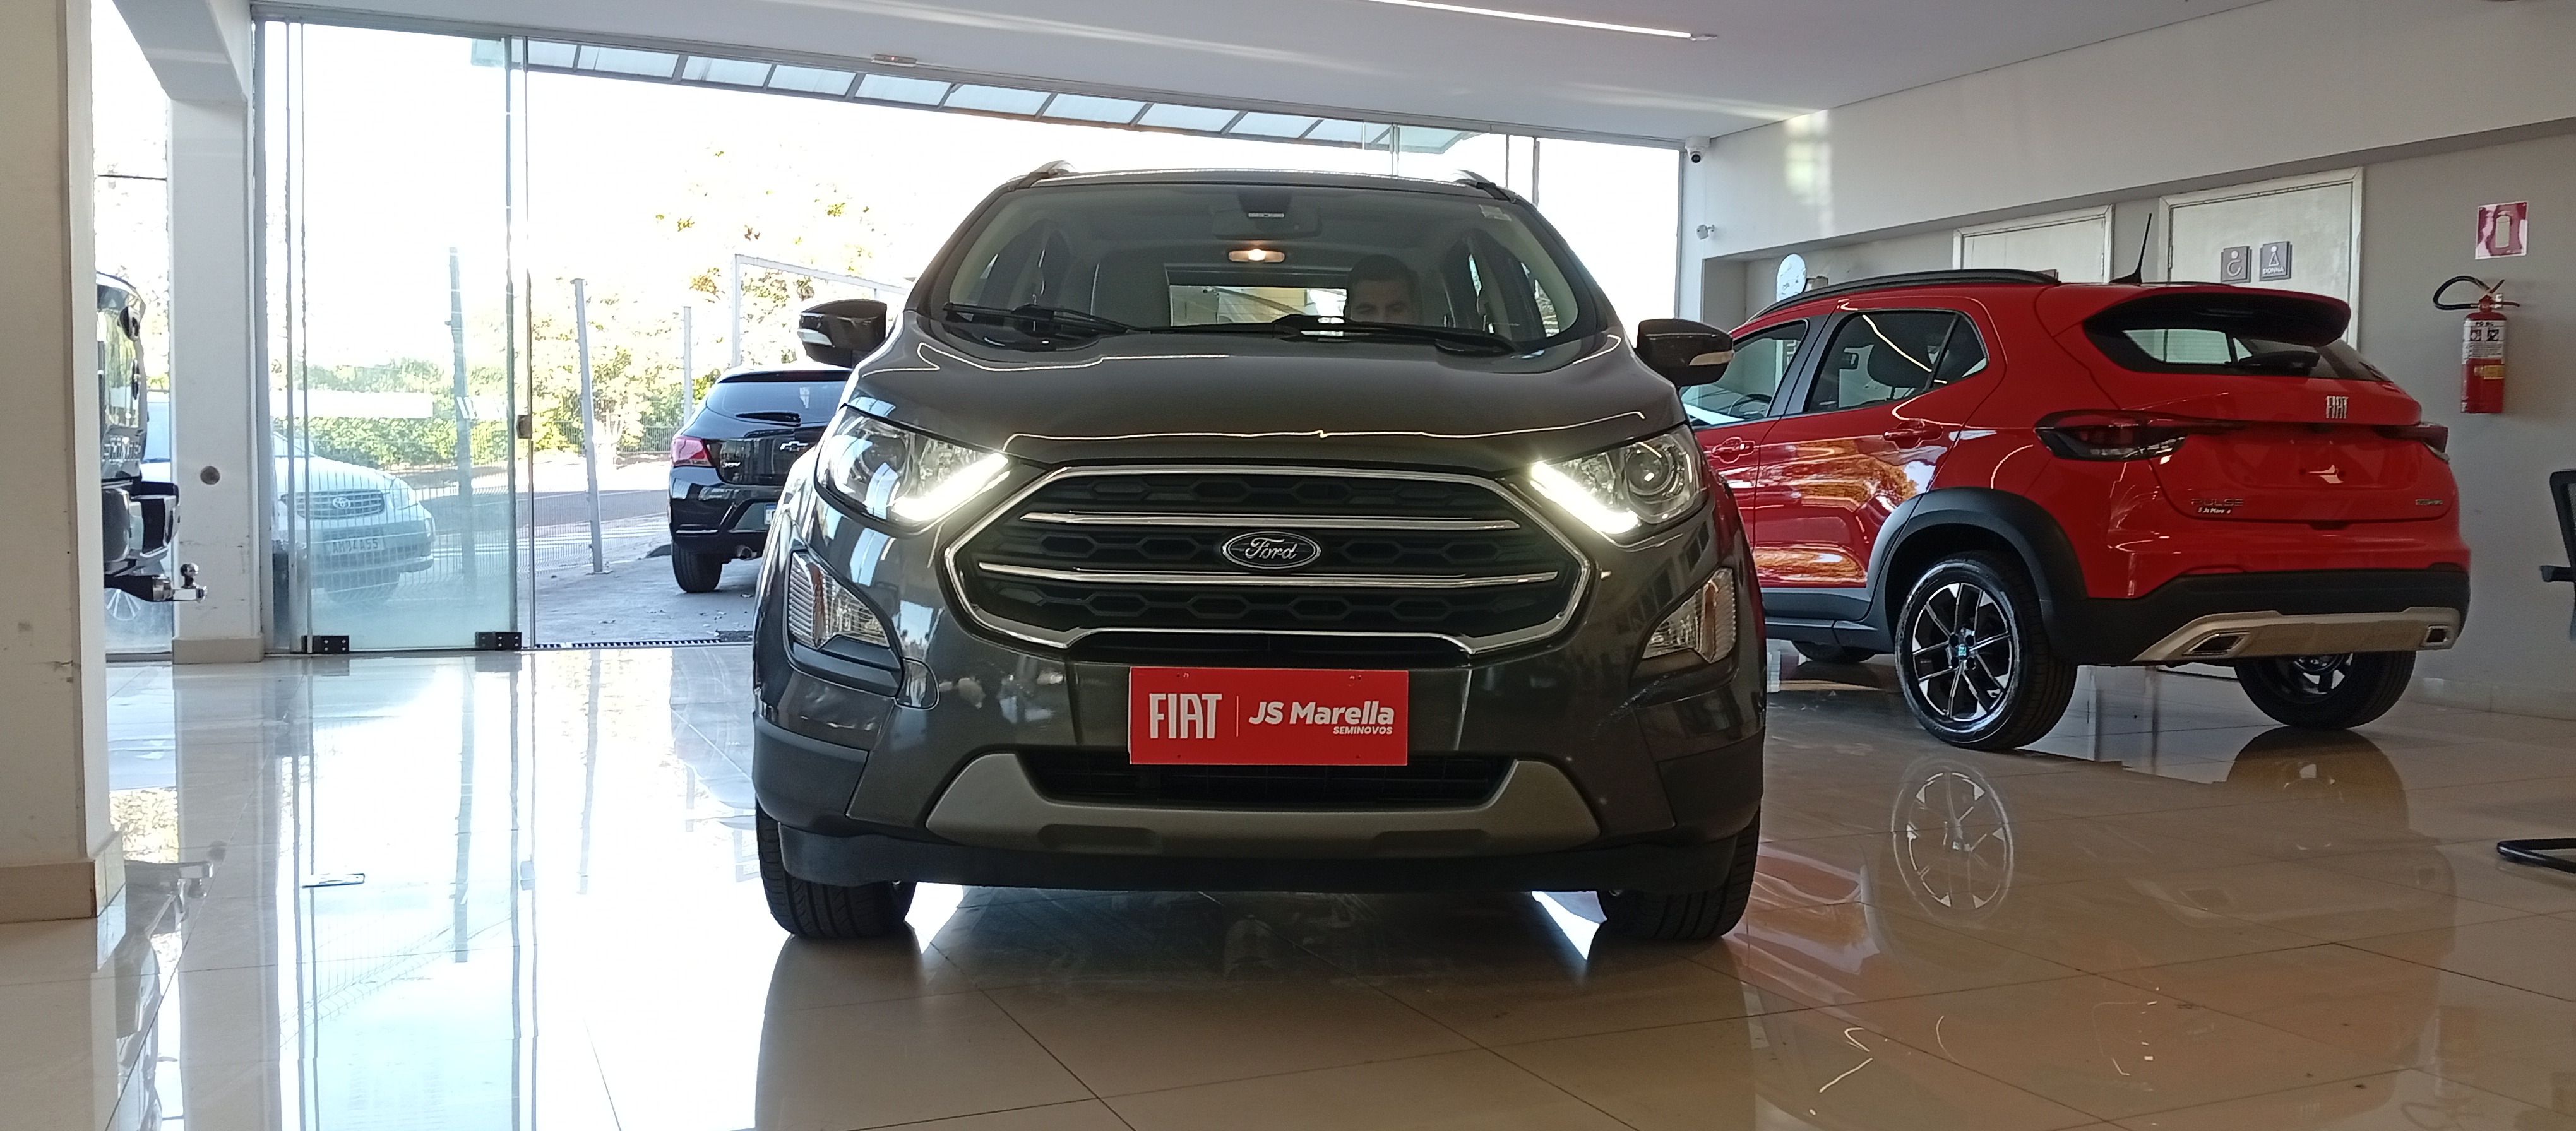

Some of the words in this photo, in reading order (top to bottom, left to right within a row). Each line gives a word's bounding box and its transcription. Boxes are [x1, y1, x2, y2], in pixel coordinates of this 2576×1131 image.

[2262, 266, 2284, 275] DONNA
[2326, 396, 2349, 419] FIAT
[2191, 498, 2243, 506] PULSE
[1244, 537, 1298, 559] Ford
[1149, 693, 1222, 739] FIAT
[1248, 701, 1284, 725] JS
[1289, 701, 1395, 725] Marella
[1333, 726, 1393, 735] SEMINOVOS
